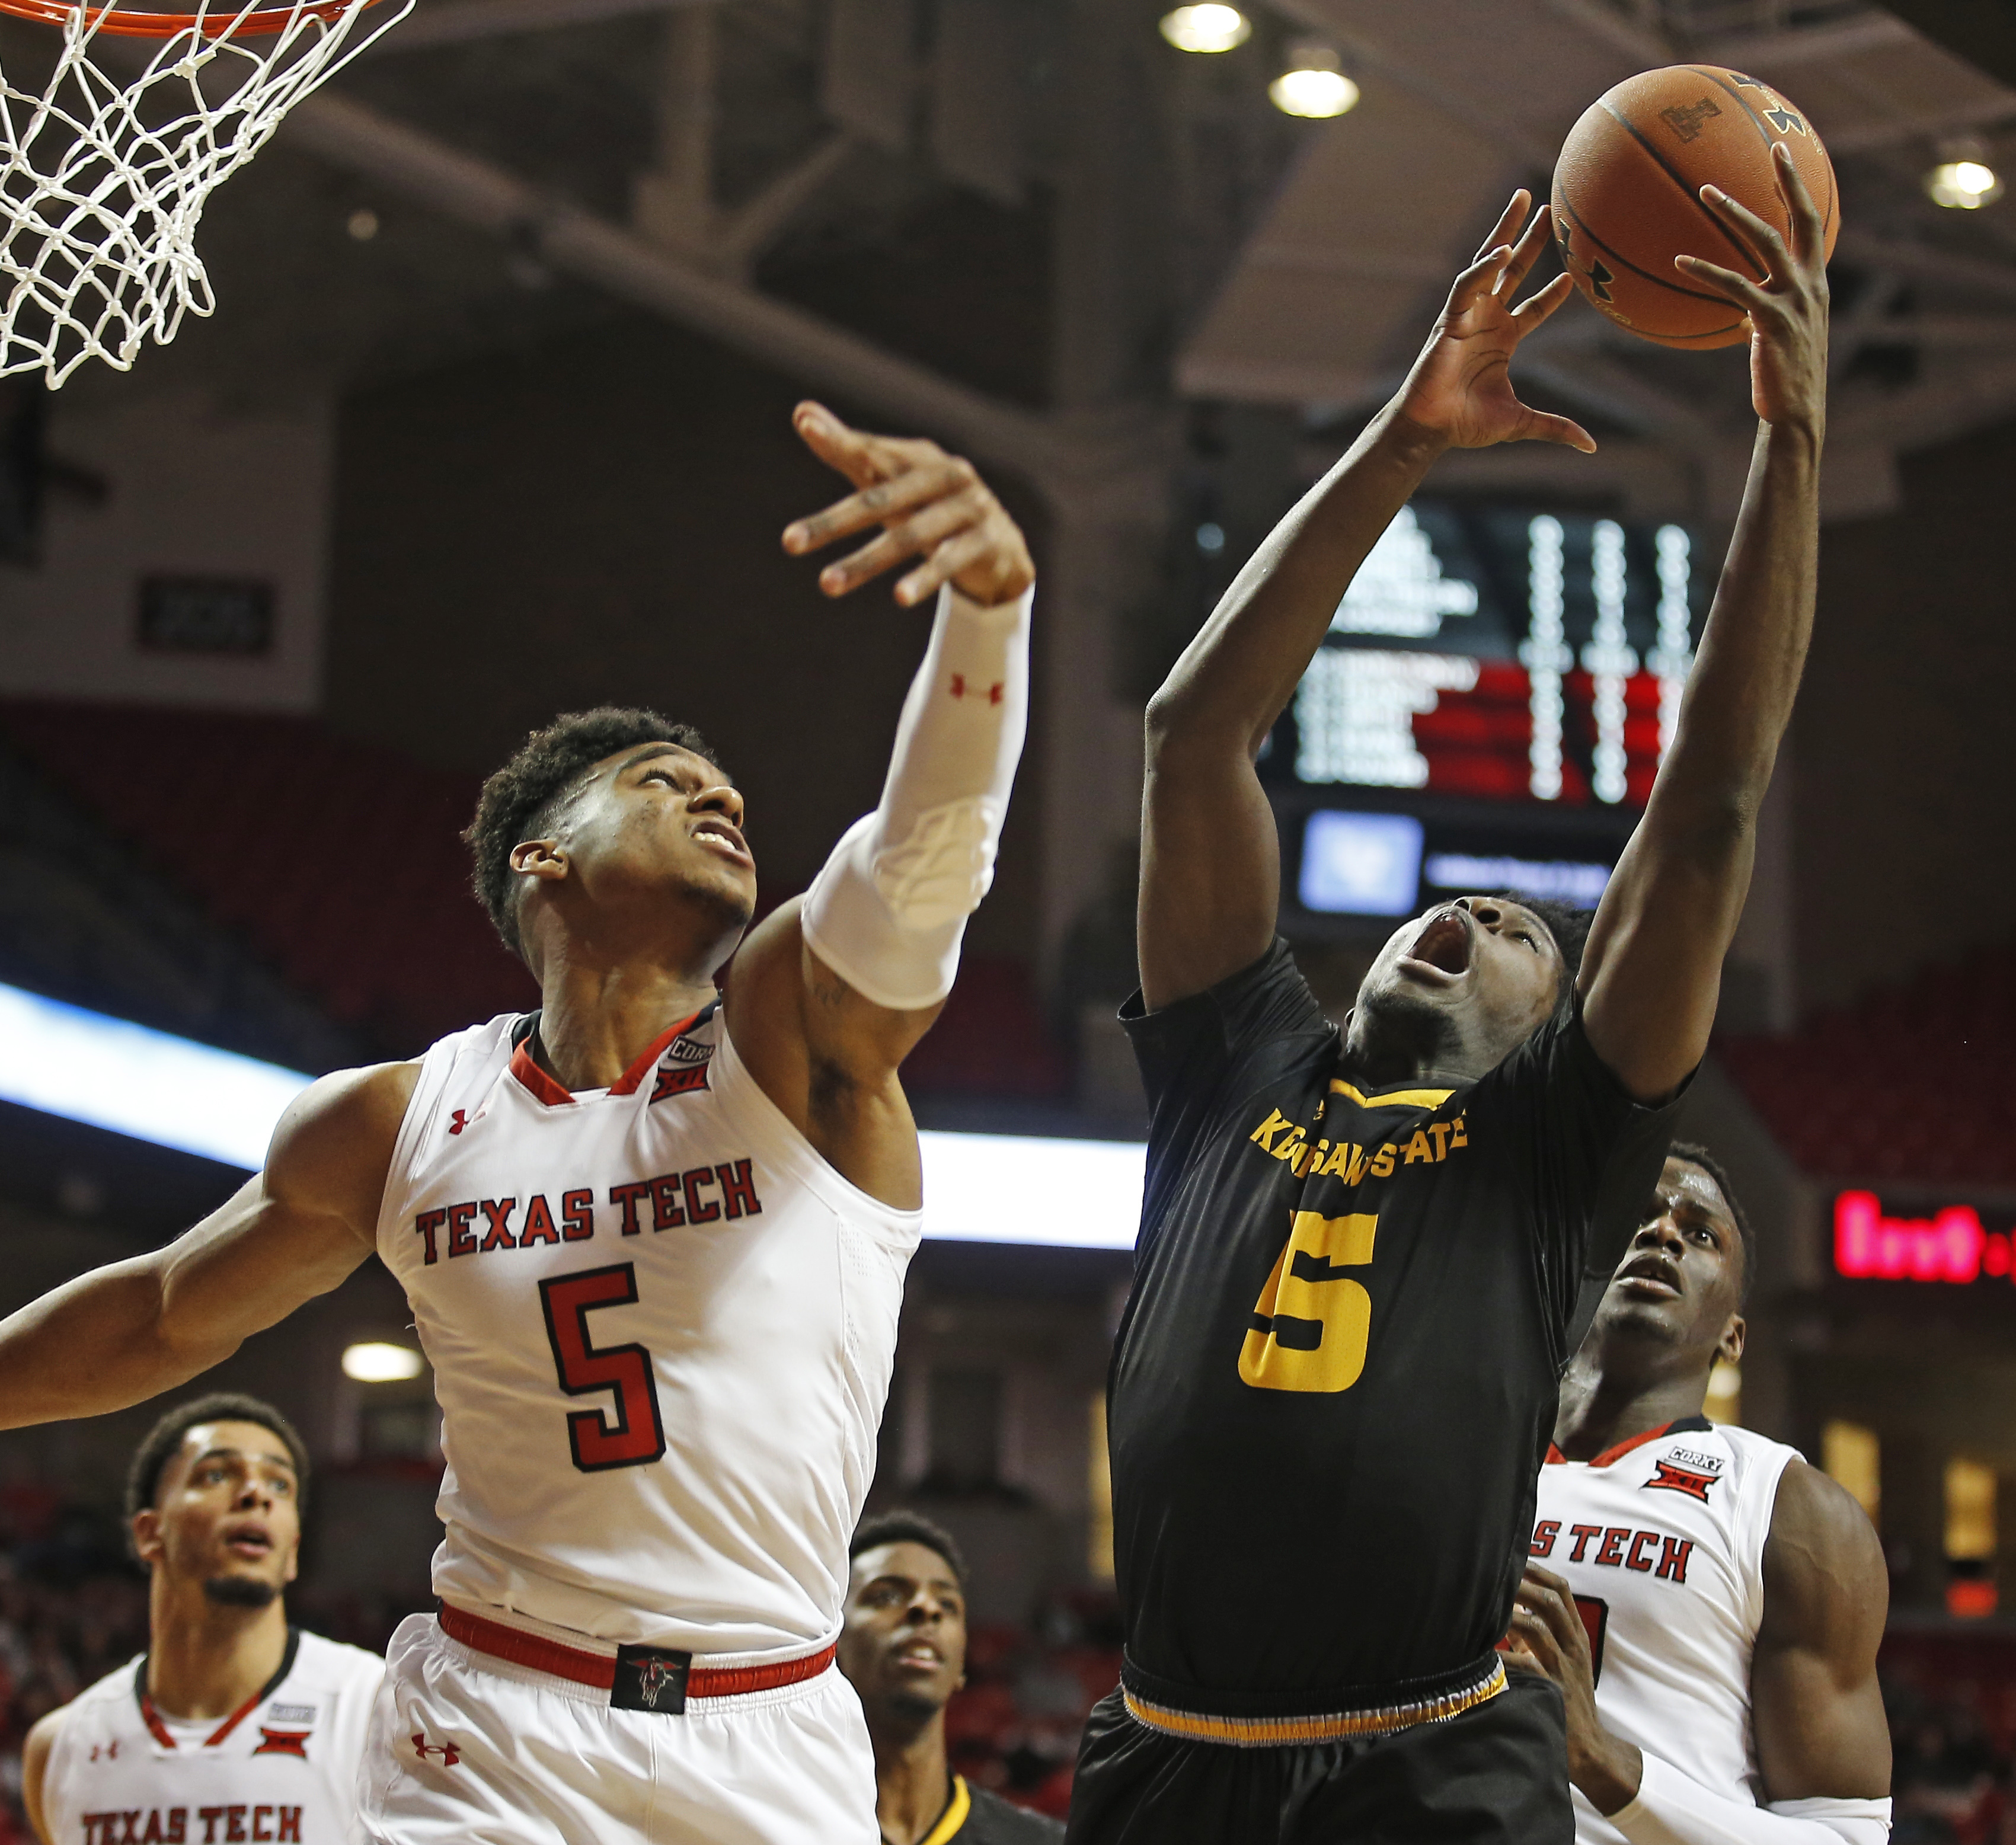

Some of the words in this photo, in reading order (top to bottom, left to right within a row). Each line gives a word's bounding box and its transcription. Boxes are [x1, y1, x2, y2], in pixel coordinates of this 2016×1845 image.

[416, 1188, 594, 1265] TEXAS
[610, 1158, 762, 1236] TECH
[1237, 1209, 1379, 1393] 5
[538, 1261, 666, 1473] 5
[1669, 1447, 1724, 1472] CORKY
[1568, 1523, 1694, 1584] TECH
[82, 1807, 187, 1845] TEXAS
[199, 1805, 302, 1844] TECH
